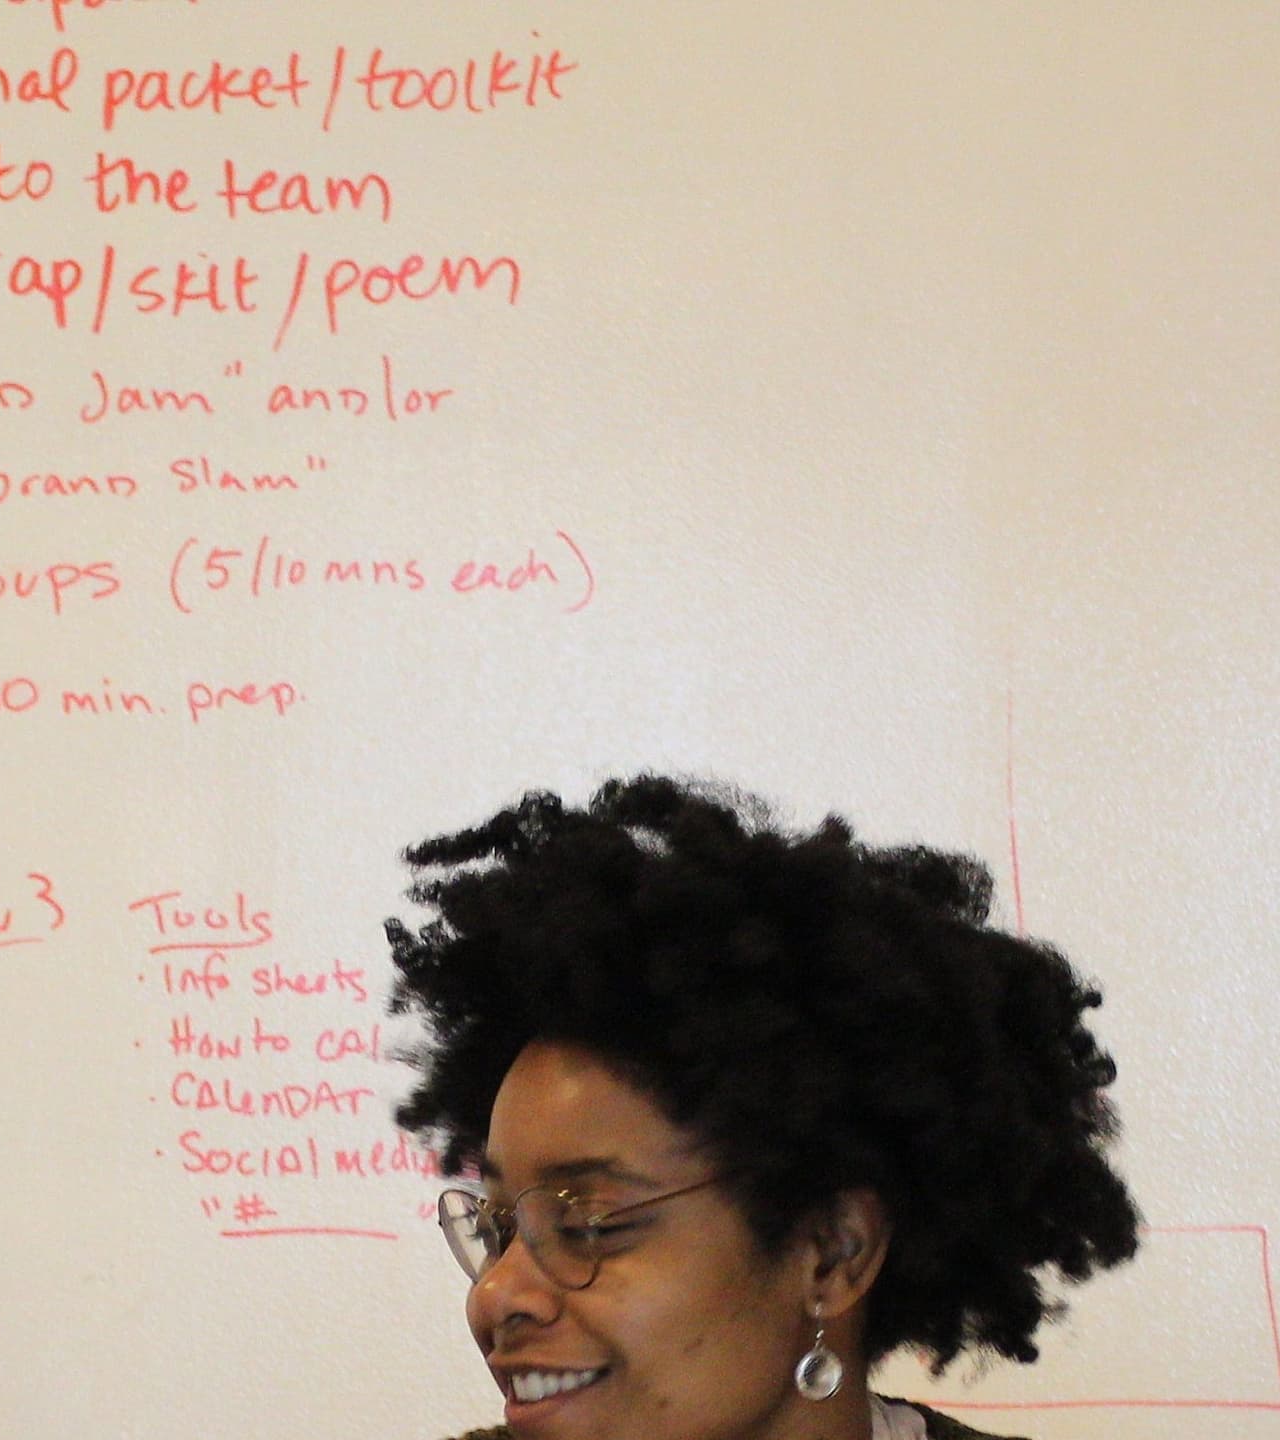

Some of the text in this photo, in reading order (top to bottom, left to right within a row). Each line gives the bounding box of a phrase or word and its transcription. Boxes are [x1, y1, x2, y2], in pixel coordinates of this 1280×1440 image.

[103, 31, 577, 132] packet/toolkit
[85, 152, 197, 213] the
[216, 159, 391, 222] team
[187, 680, 308, 722] prep.
[129, 892, 272, 942] Tools
[164, 950, 367, 1002] Info sheets
[253, 1018, 290, 1052] to
